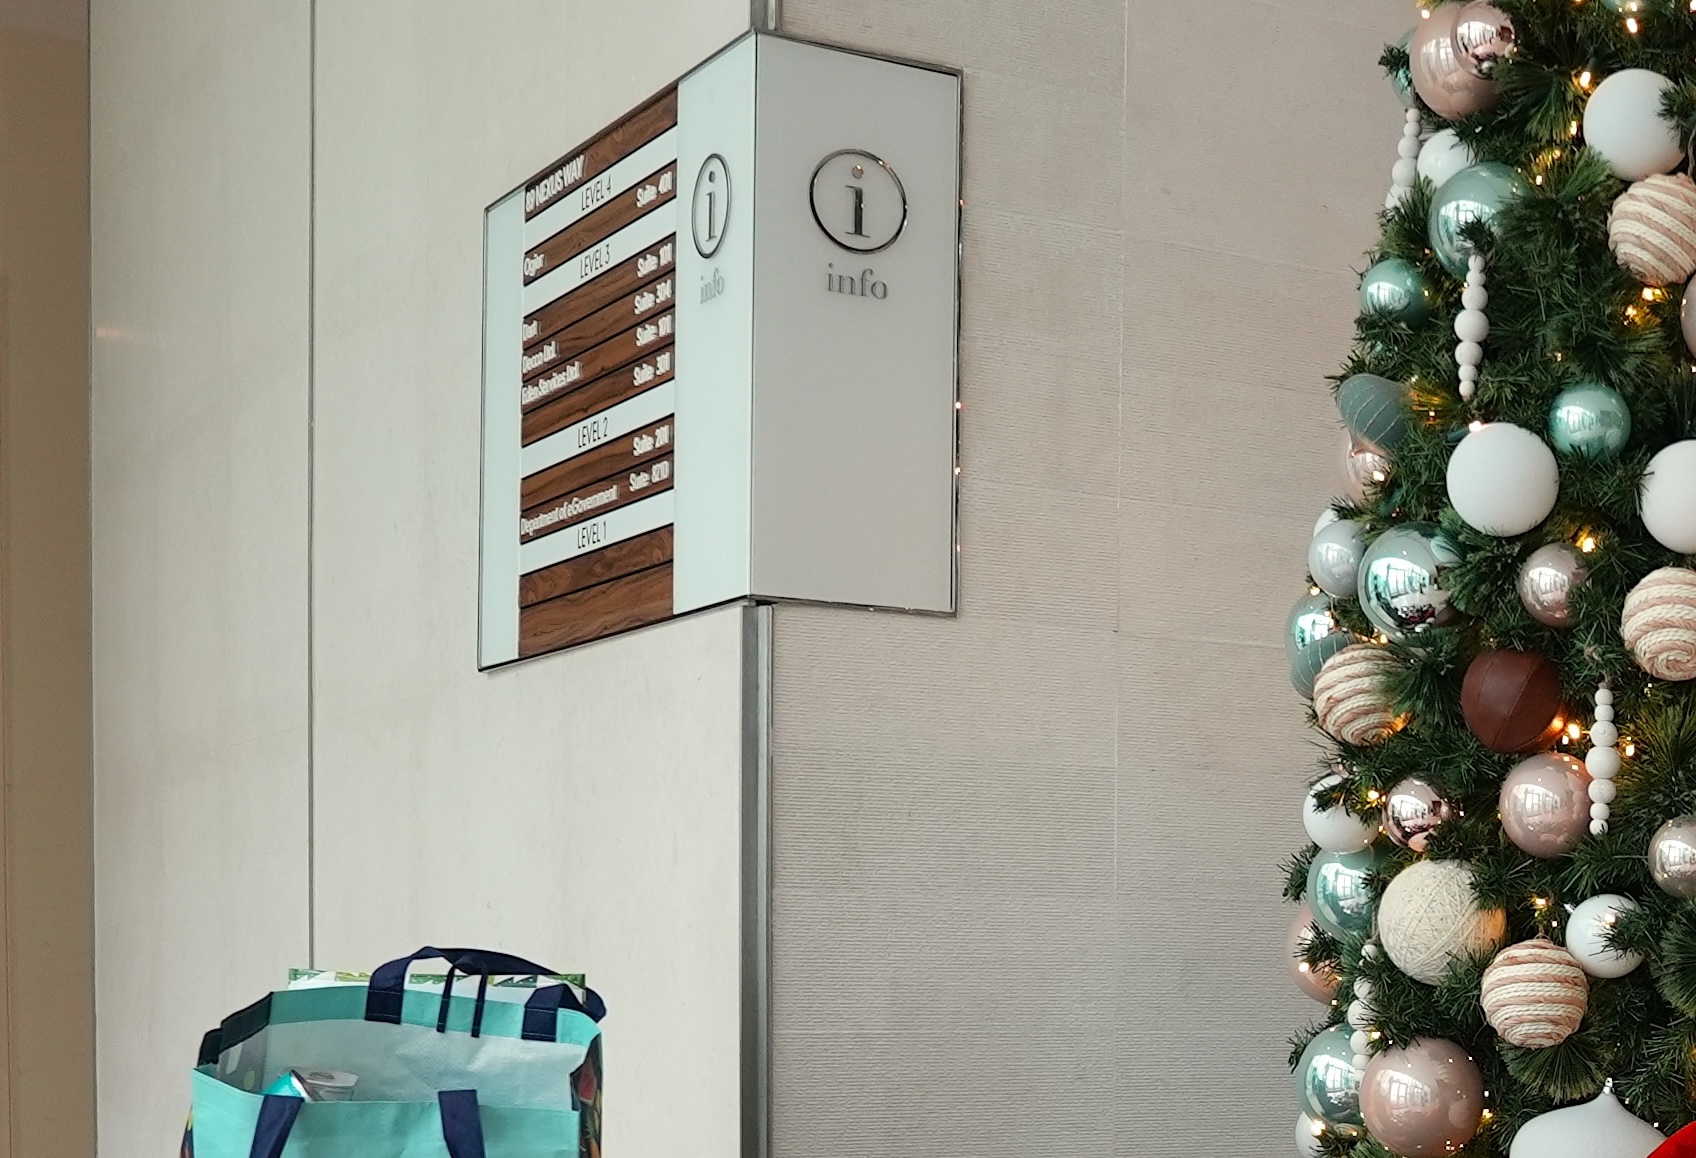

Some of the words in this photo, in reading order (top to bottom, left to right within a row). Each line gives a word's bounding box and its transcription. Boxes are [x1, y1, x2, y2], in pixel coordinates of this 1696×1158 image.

[535, 168, 564, 206] NEXUS
[563, 154, 585, 186] WAY
[581, 179, 605, 212] LEVEL
[606, 173, 612, 195] 4
[636, 184, 658, 208] Suite
[580, 247, 604, 279] LEVEL
[605, 243, 611, 265] 3
[637, 253, 659, 278] Suite
[700, 267, 725, 304] info
[827, 262, 889, 299] info
[634, 291, 656, 315] Suite
[635, 323, 658, 347] Suite
[633, 363, 655, 387] Suite
[577, 420, 601, 448] LEVEL
[603, 417, 609, 438] 2
[632, 433, 655, 457] Suite
[629, 471, 651, 492] Suite
[521, 507, 559, 536] Department
[577, 524, 601, 549] LEVEL
[603, 521, 608, 541] 1
